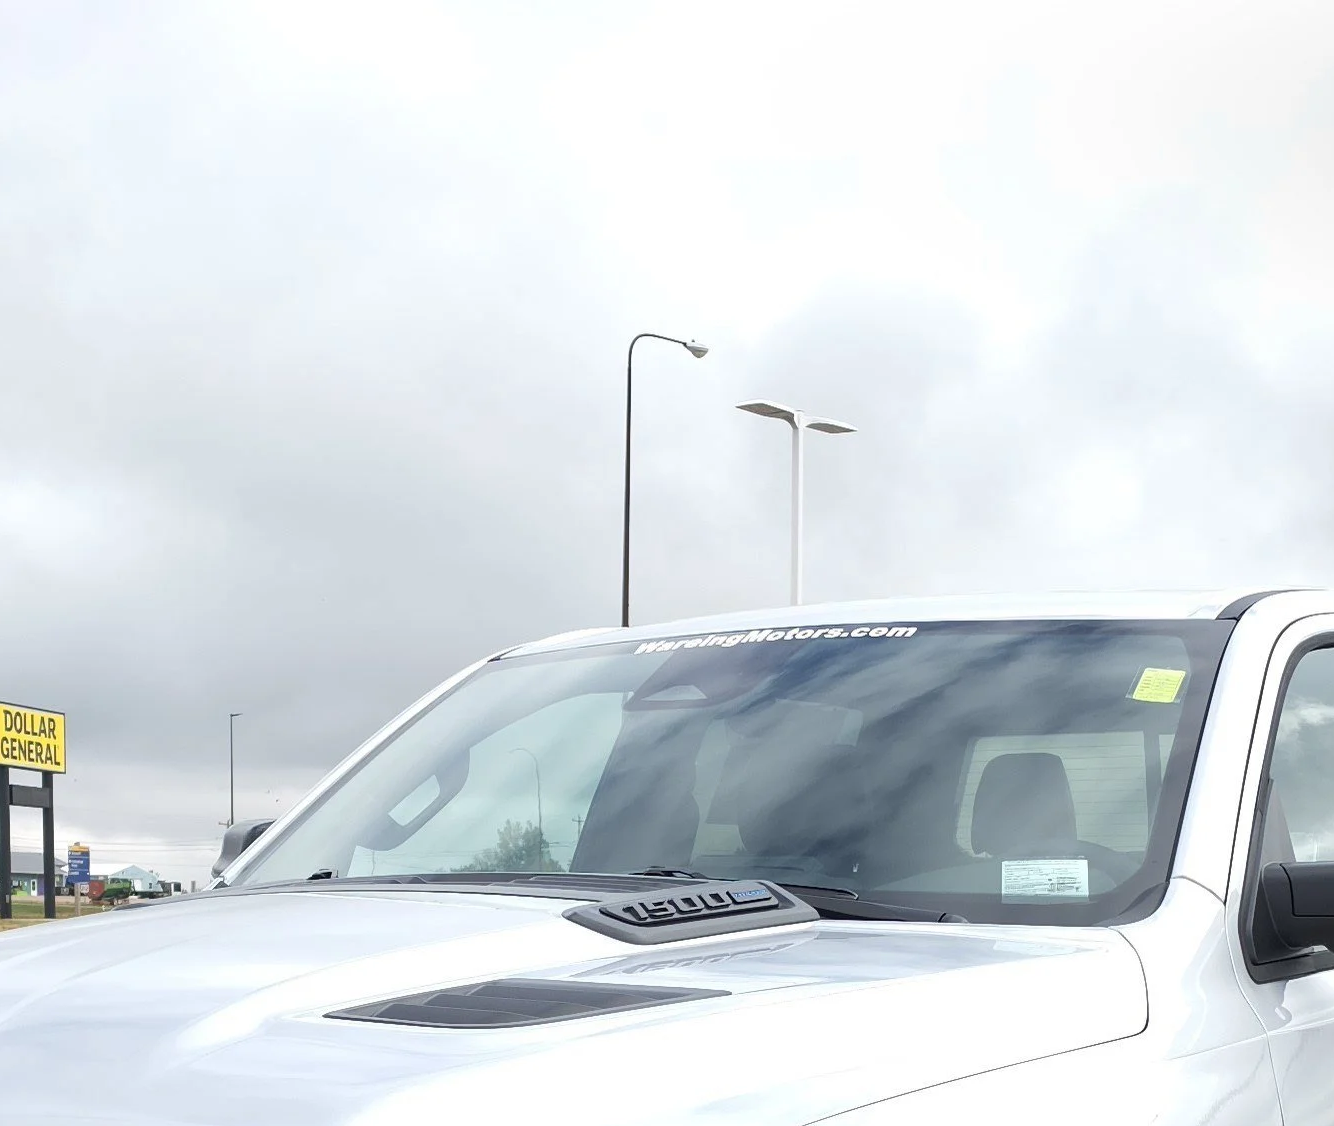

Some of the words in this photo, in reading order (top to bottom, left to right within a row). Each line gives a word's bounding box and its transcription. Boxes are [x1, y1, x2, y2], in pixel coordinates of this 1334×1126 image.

[634, 626, 917, 655] WareingMotors.com
[3, 709, 56, 740] DOLLAR
[0, 736, 61, 766] GENERAL
[622, 891, 731, 921] 1500
